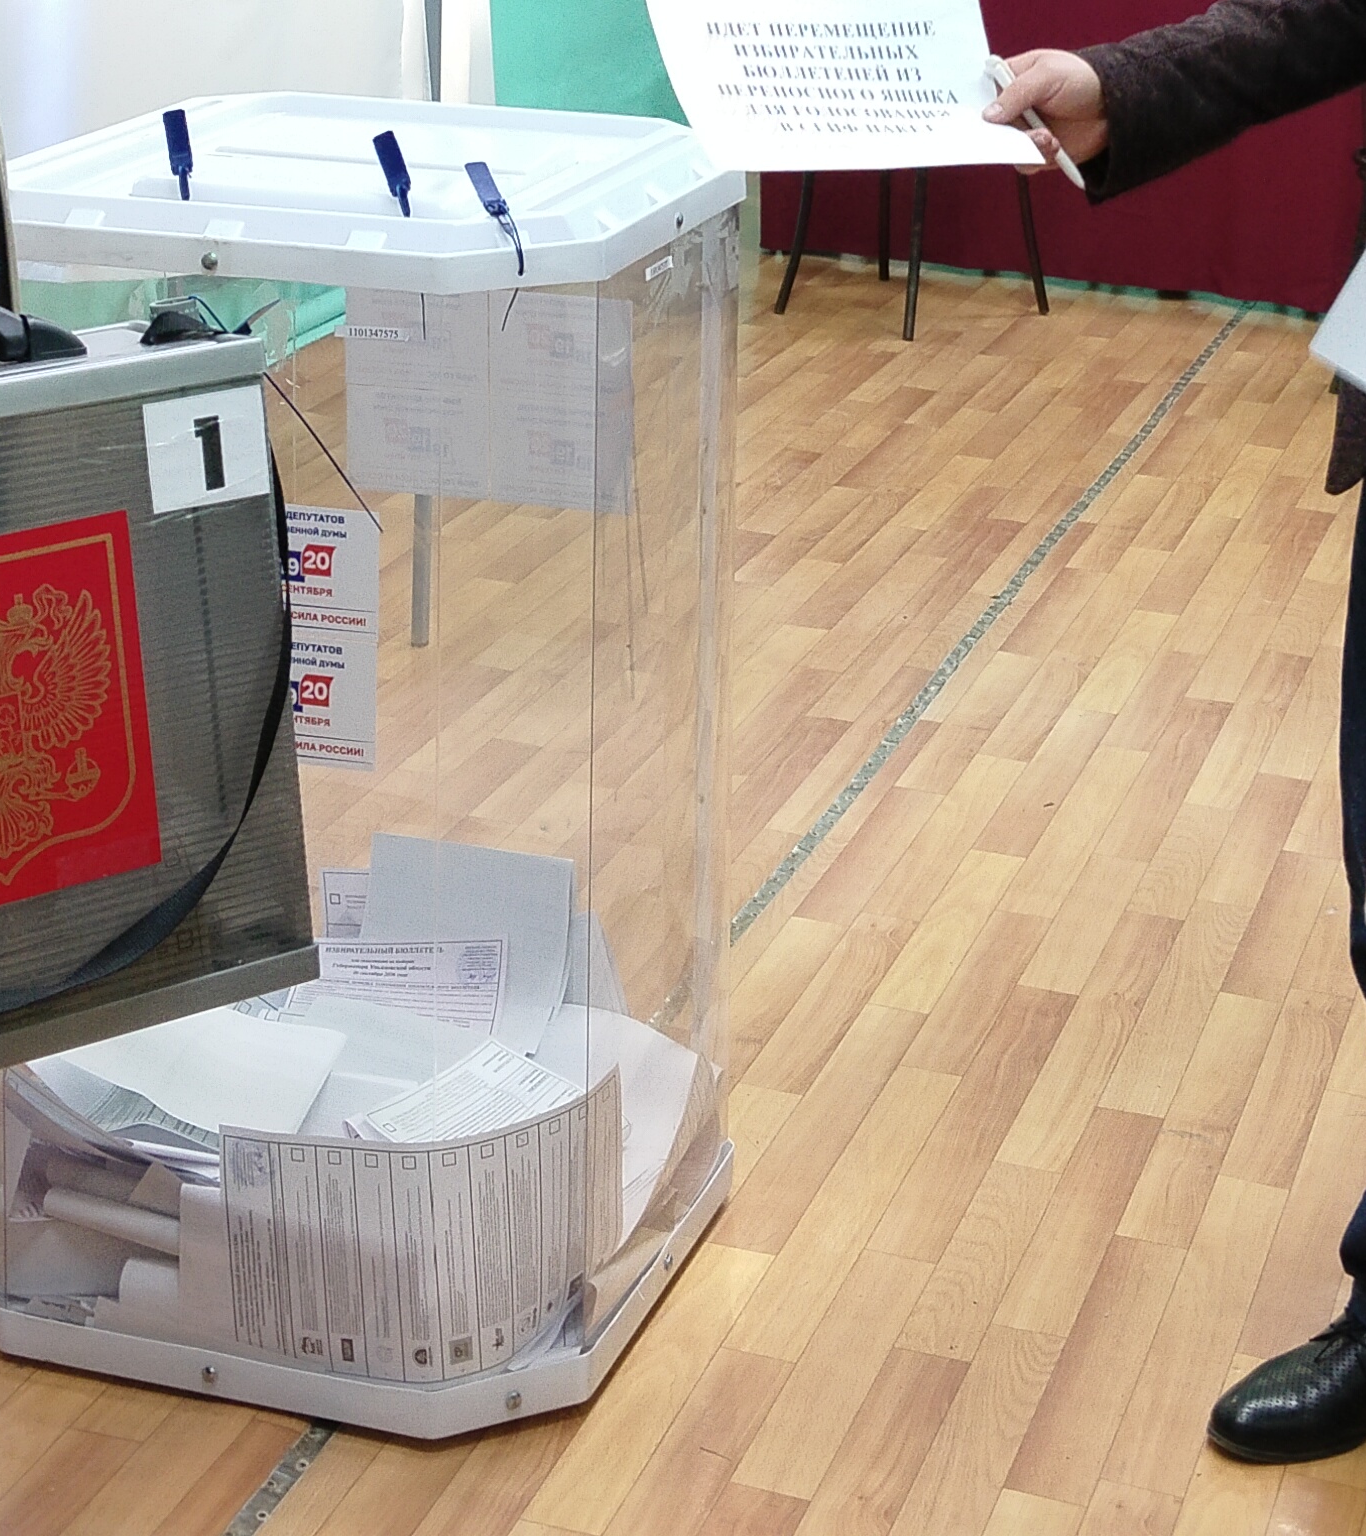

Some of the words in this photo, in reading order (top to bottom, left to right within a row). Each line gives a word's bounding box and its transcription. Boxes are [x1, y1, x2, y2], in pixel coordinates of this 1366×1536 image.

[706, 22, 761, 38] ИДЕТ
[770, 20, 936, 40] ПЕРЕМЕЩЕНИЕ
[734, 43, 919, 60] ИЗБИРАТЕЛЬНЫХ
[743, 64, 889, 82] БЮЛЛЕТЕНЕЙ
[897, 66, 922, 82] ИЗ
[718, 84, 875, 101] ПЕРЕНОСНОГО
[881, 88, 959, 105] ЯЩИКА
[348, 327, 400, 340] 1101347575
[191, 413, 227, 492] 1
[286, 510, 346, 525] ДЕПУТАТОВ
[320, 528, 347, 539] ДУМЫ
[303, 550, 331, 571] 20
[290, 610, 319, 622] СИЛА
[321, 613, 367, 627] РОССИИ!
[291, 641, 343, 655] ЕПУТАТОВ
[318, 657, 345, 669] ДУМЫ
[301, 682, 329, 700] 20
[294, 715, 331, 727] НТЯБРЯ
[295, 741, 317, 752] ИЛА
[318, 744, 365, 757] РОССИИ!
[395, 946, 445, 954] БЮЛЛЕТЕЬ
